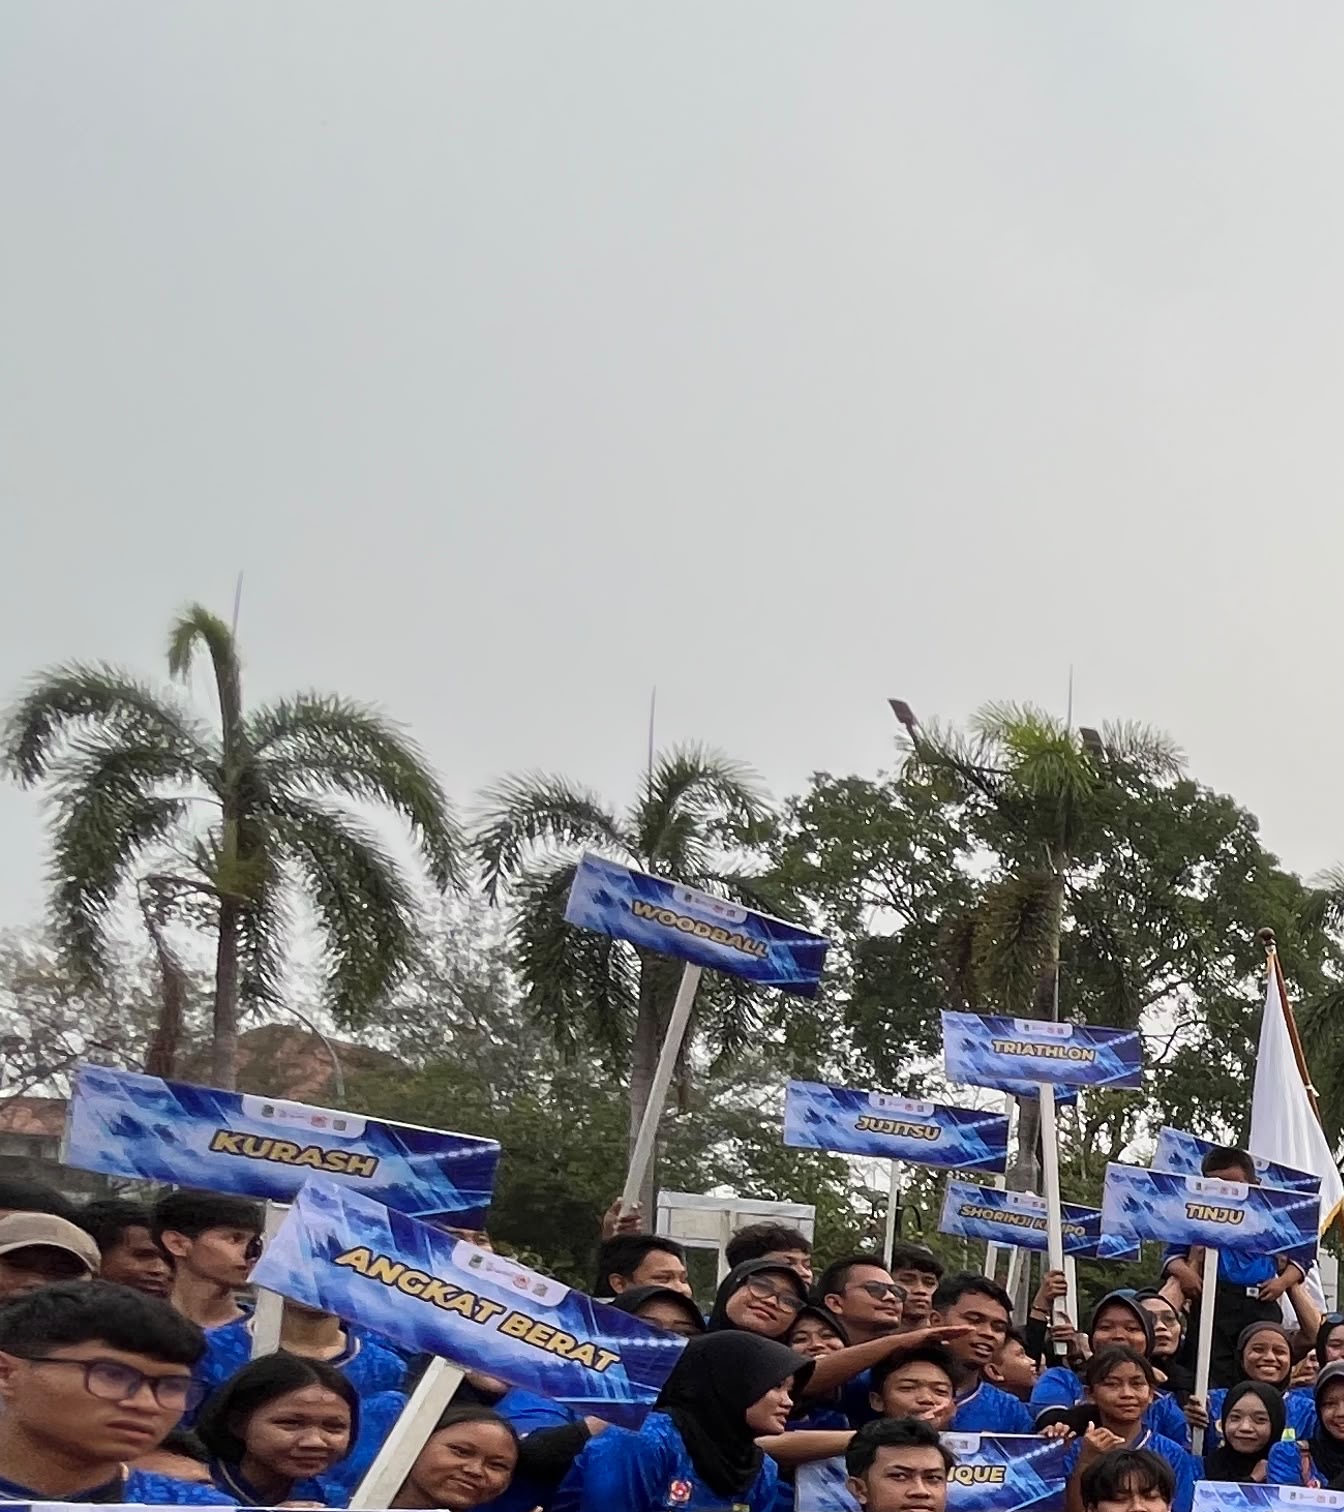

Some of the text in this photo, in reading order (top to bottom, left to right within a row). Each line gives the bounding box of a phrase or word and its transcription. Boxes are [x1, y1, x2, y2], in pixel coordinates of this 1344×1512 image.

[632, 900, 769, 958] WOODBALL
[991, 1039, 1095, 1062] TRIATHLON
[855, 1115, 942, 1141] JUJITSU
[209, 1129, 379, 1178] KURASH
[959, 1205, 1087, 1237] SHORINJI KPO
[1185, 1203, 1245, 1225] TINJU
[335, 1246, 621, 1373] ANGKAT BERAT
